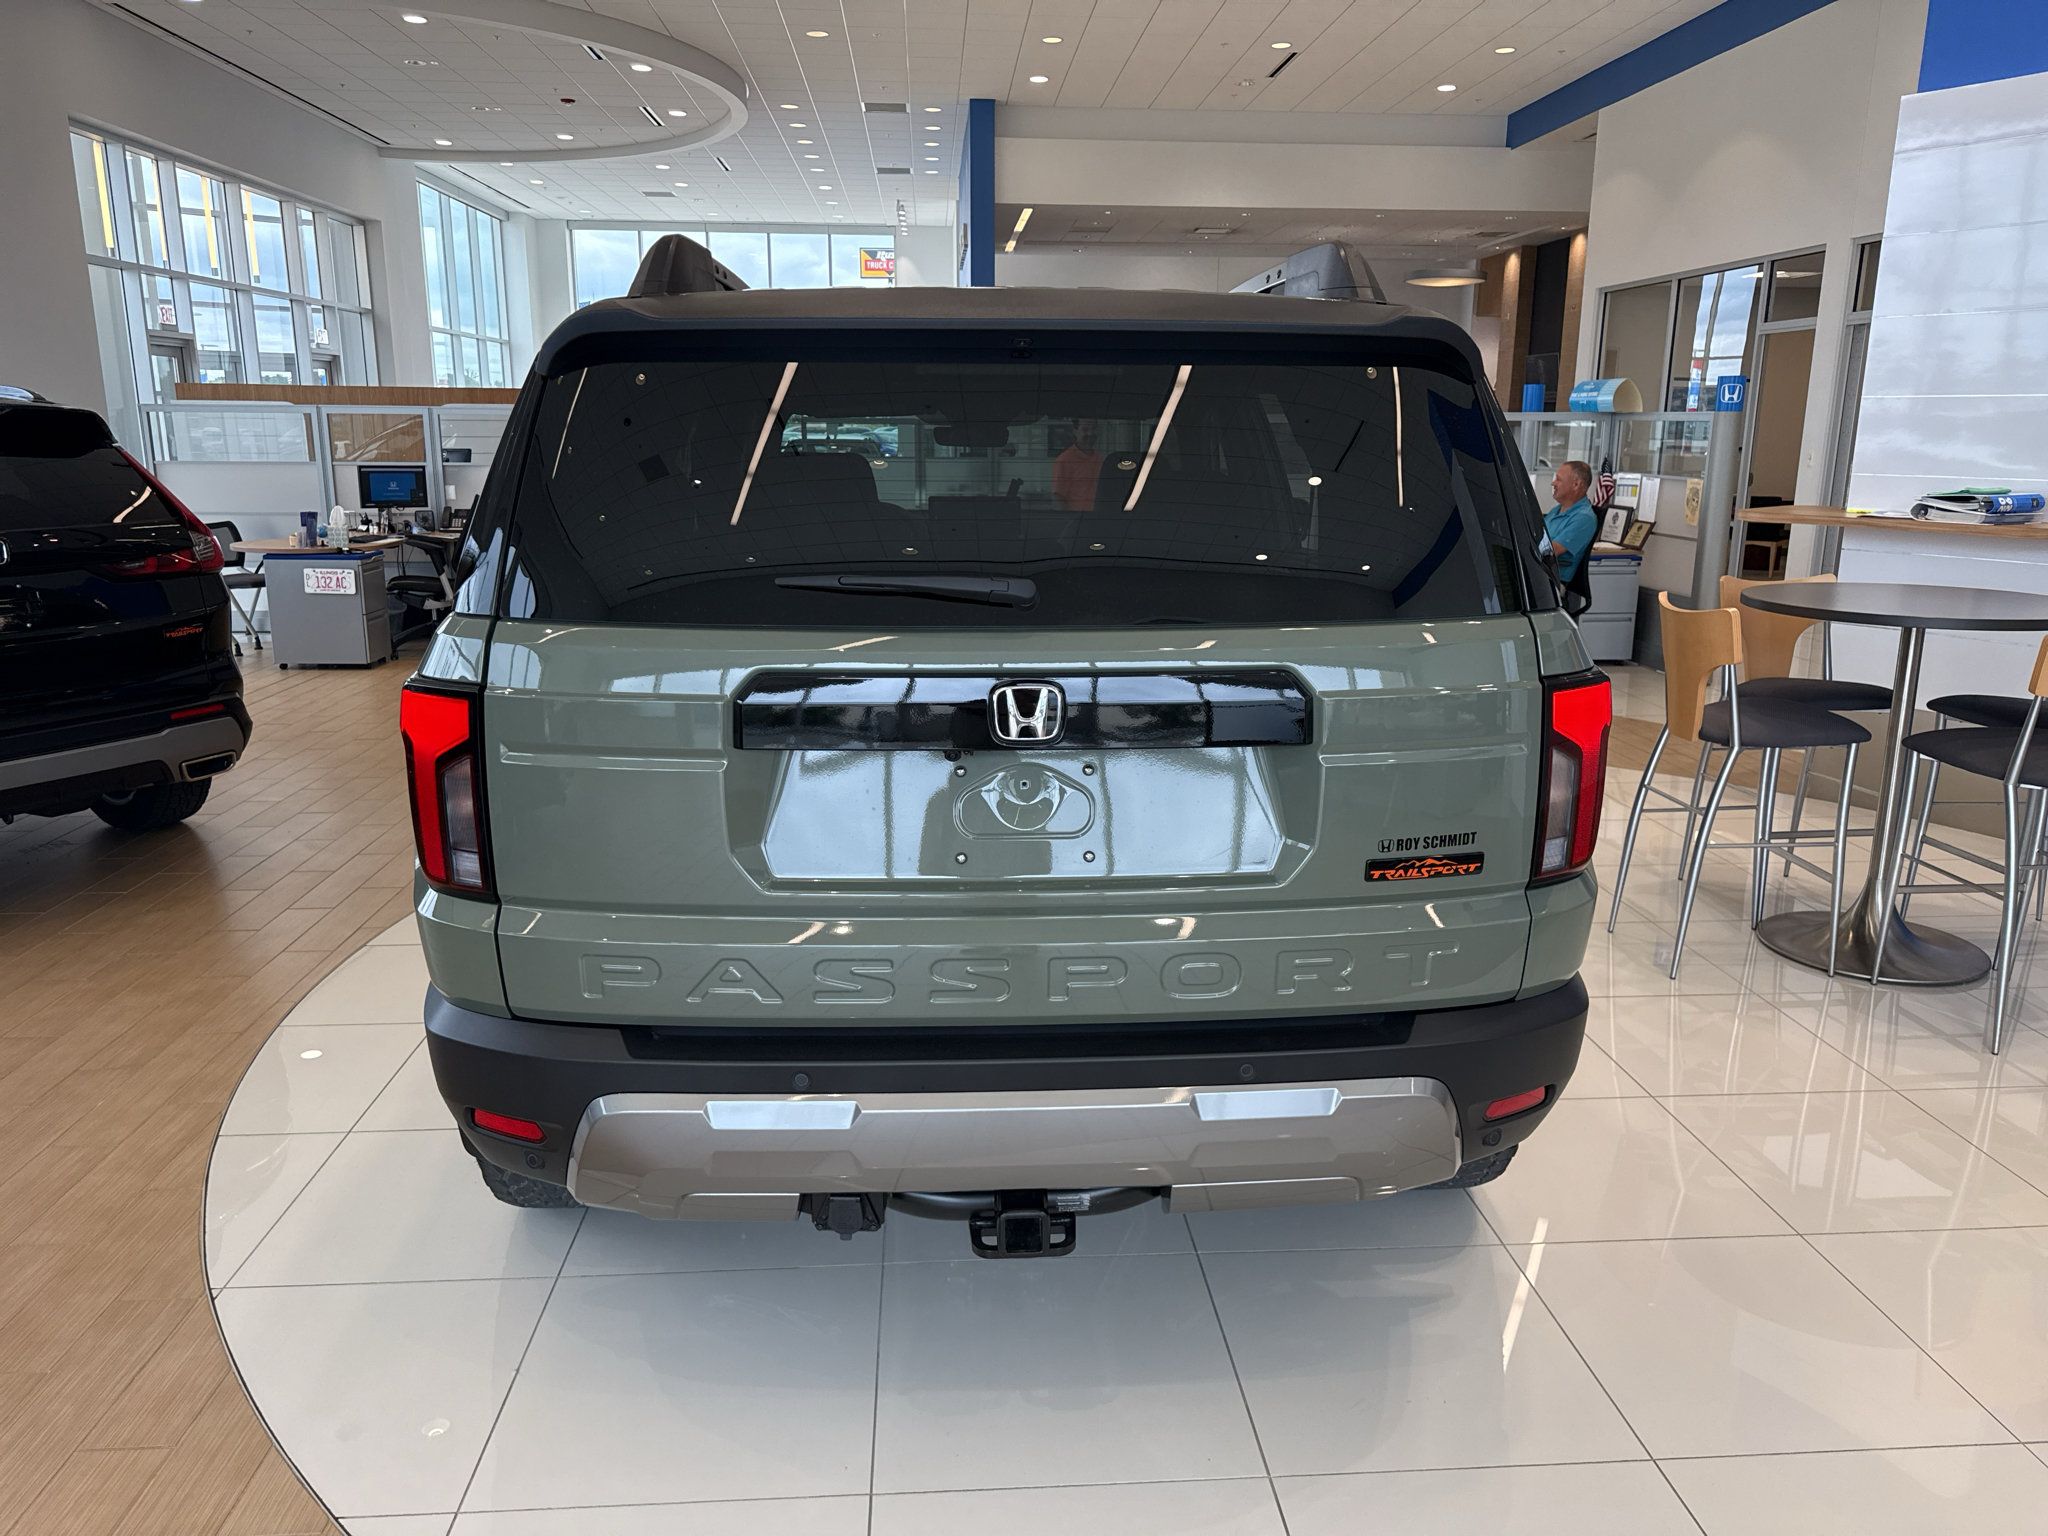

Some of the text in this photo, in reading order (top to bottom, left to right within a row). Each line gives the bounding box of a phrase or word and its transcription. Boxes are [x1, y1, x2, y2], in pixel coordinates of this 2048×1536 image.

[866, 261, 887, 269] TRUCK
[315, 576, 347, 589] 132 AC
[1396, 837, 1421, 851] ROY
[1423, 832, 1477, 849] SCHMIDT
[1370, 863, 1481, 880] TRAILSPORT
[580, 941, 1461, 1004] PASSPORT
